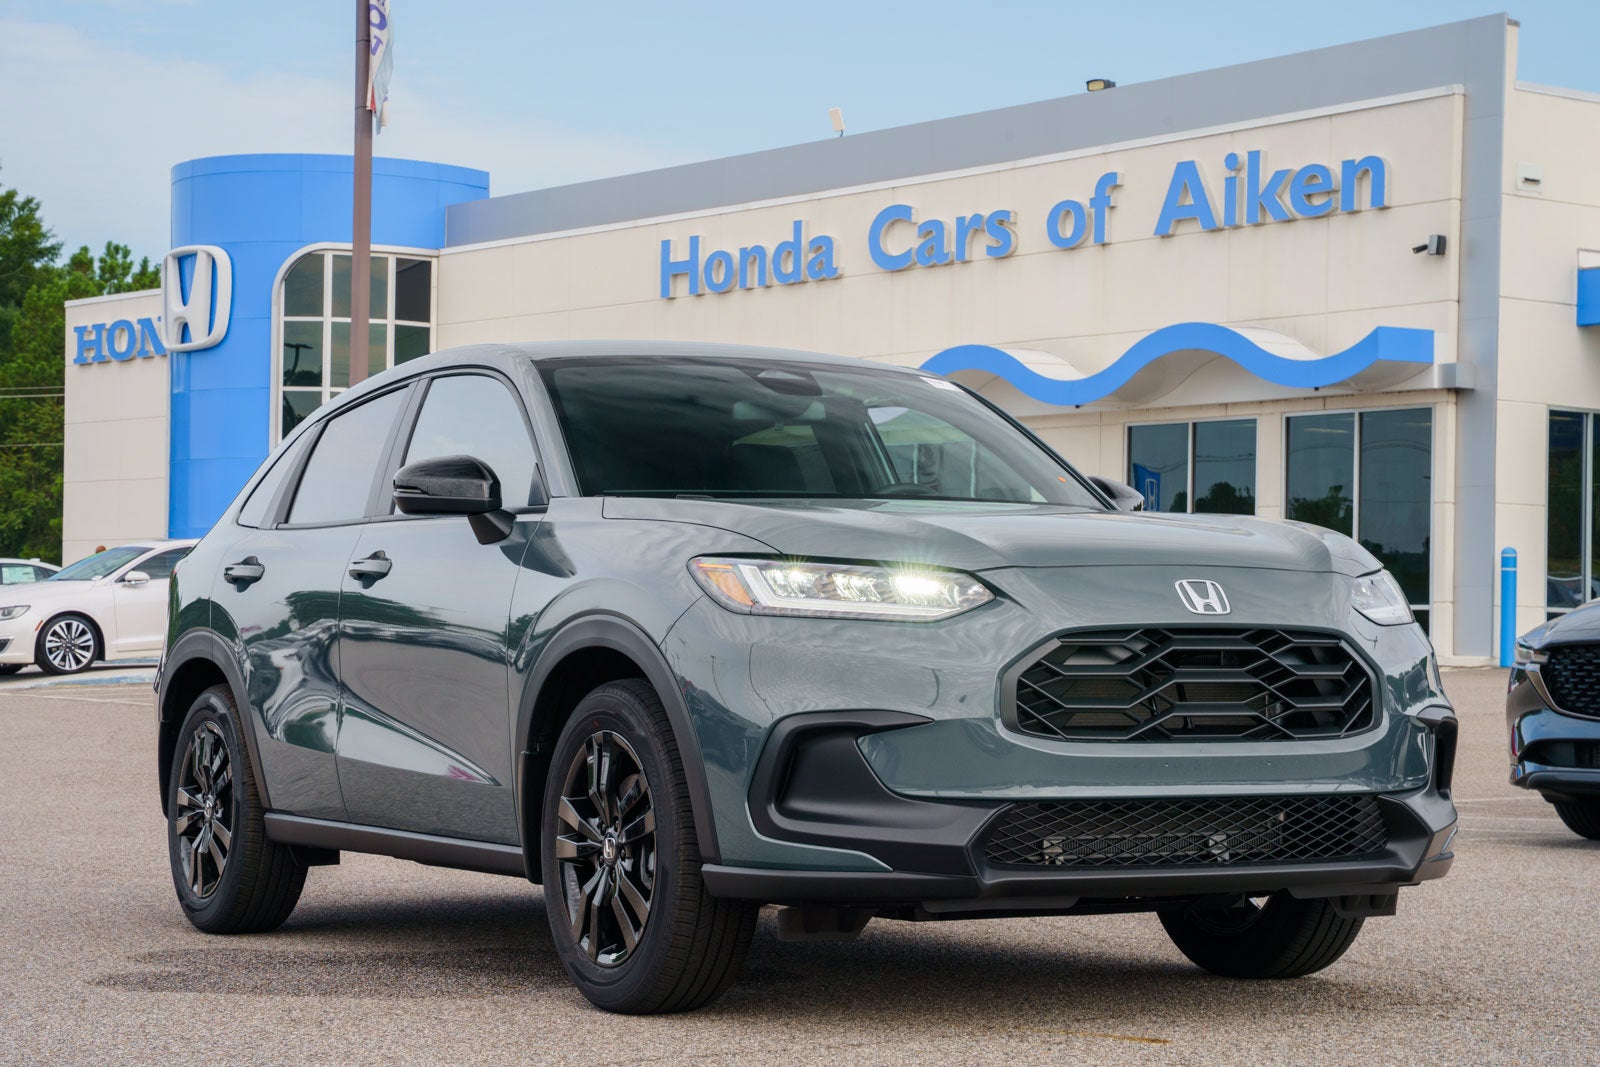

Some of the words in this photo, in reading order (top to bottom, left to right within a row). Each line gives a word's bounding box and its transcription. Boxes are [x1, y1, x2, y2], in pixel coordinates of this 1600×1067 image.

[660, 219, 839, 299] Honda
[867, 203, 1014, 272] Cars
[1046, 171, 1119, 250] of
[1153, 149, 1386, 237] Aiken
